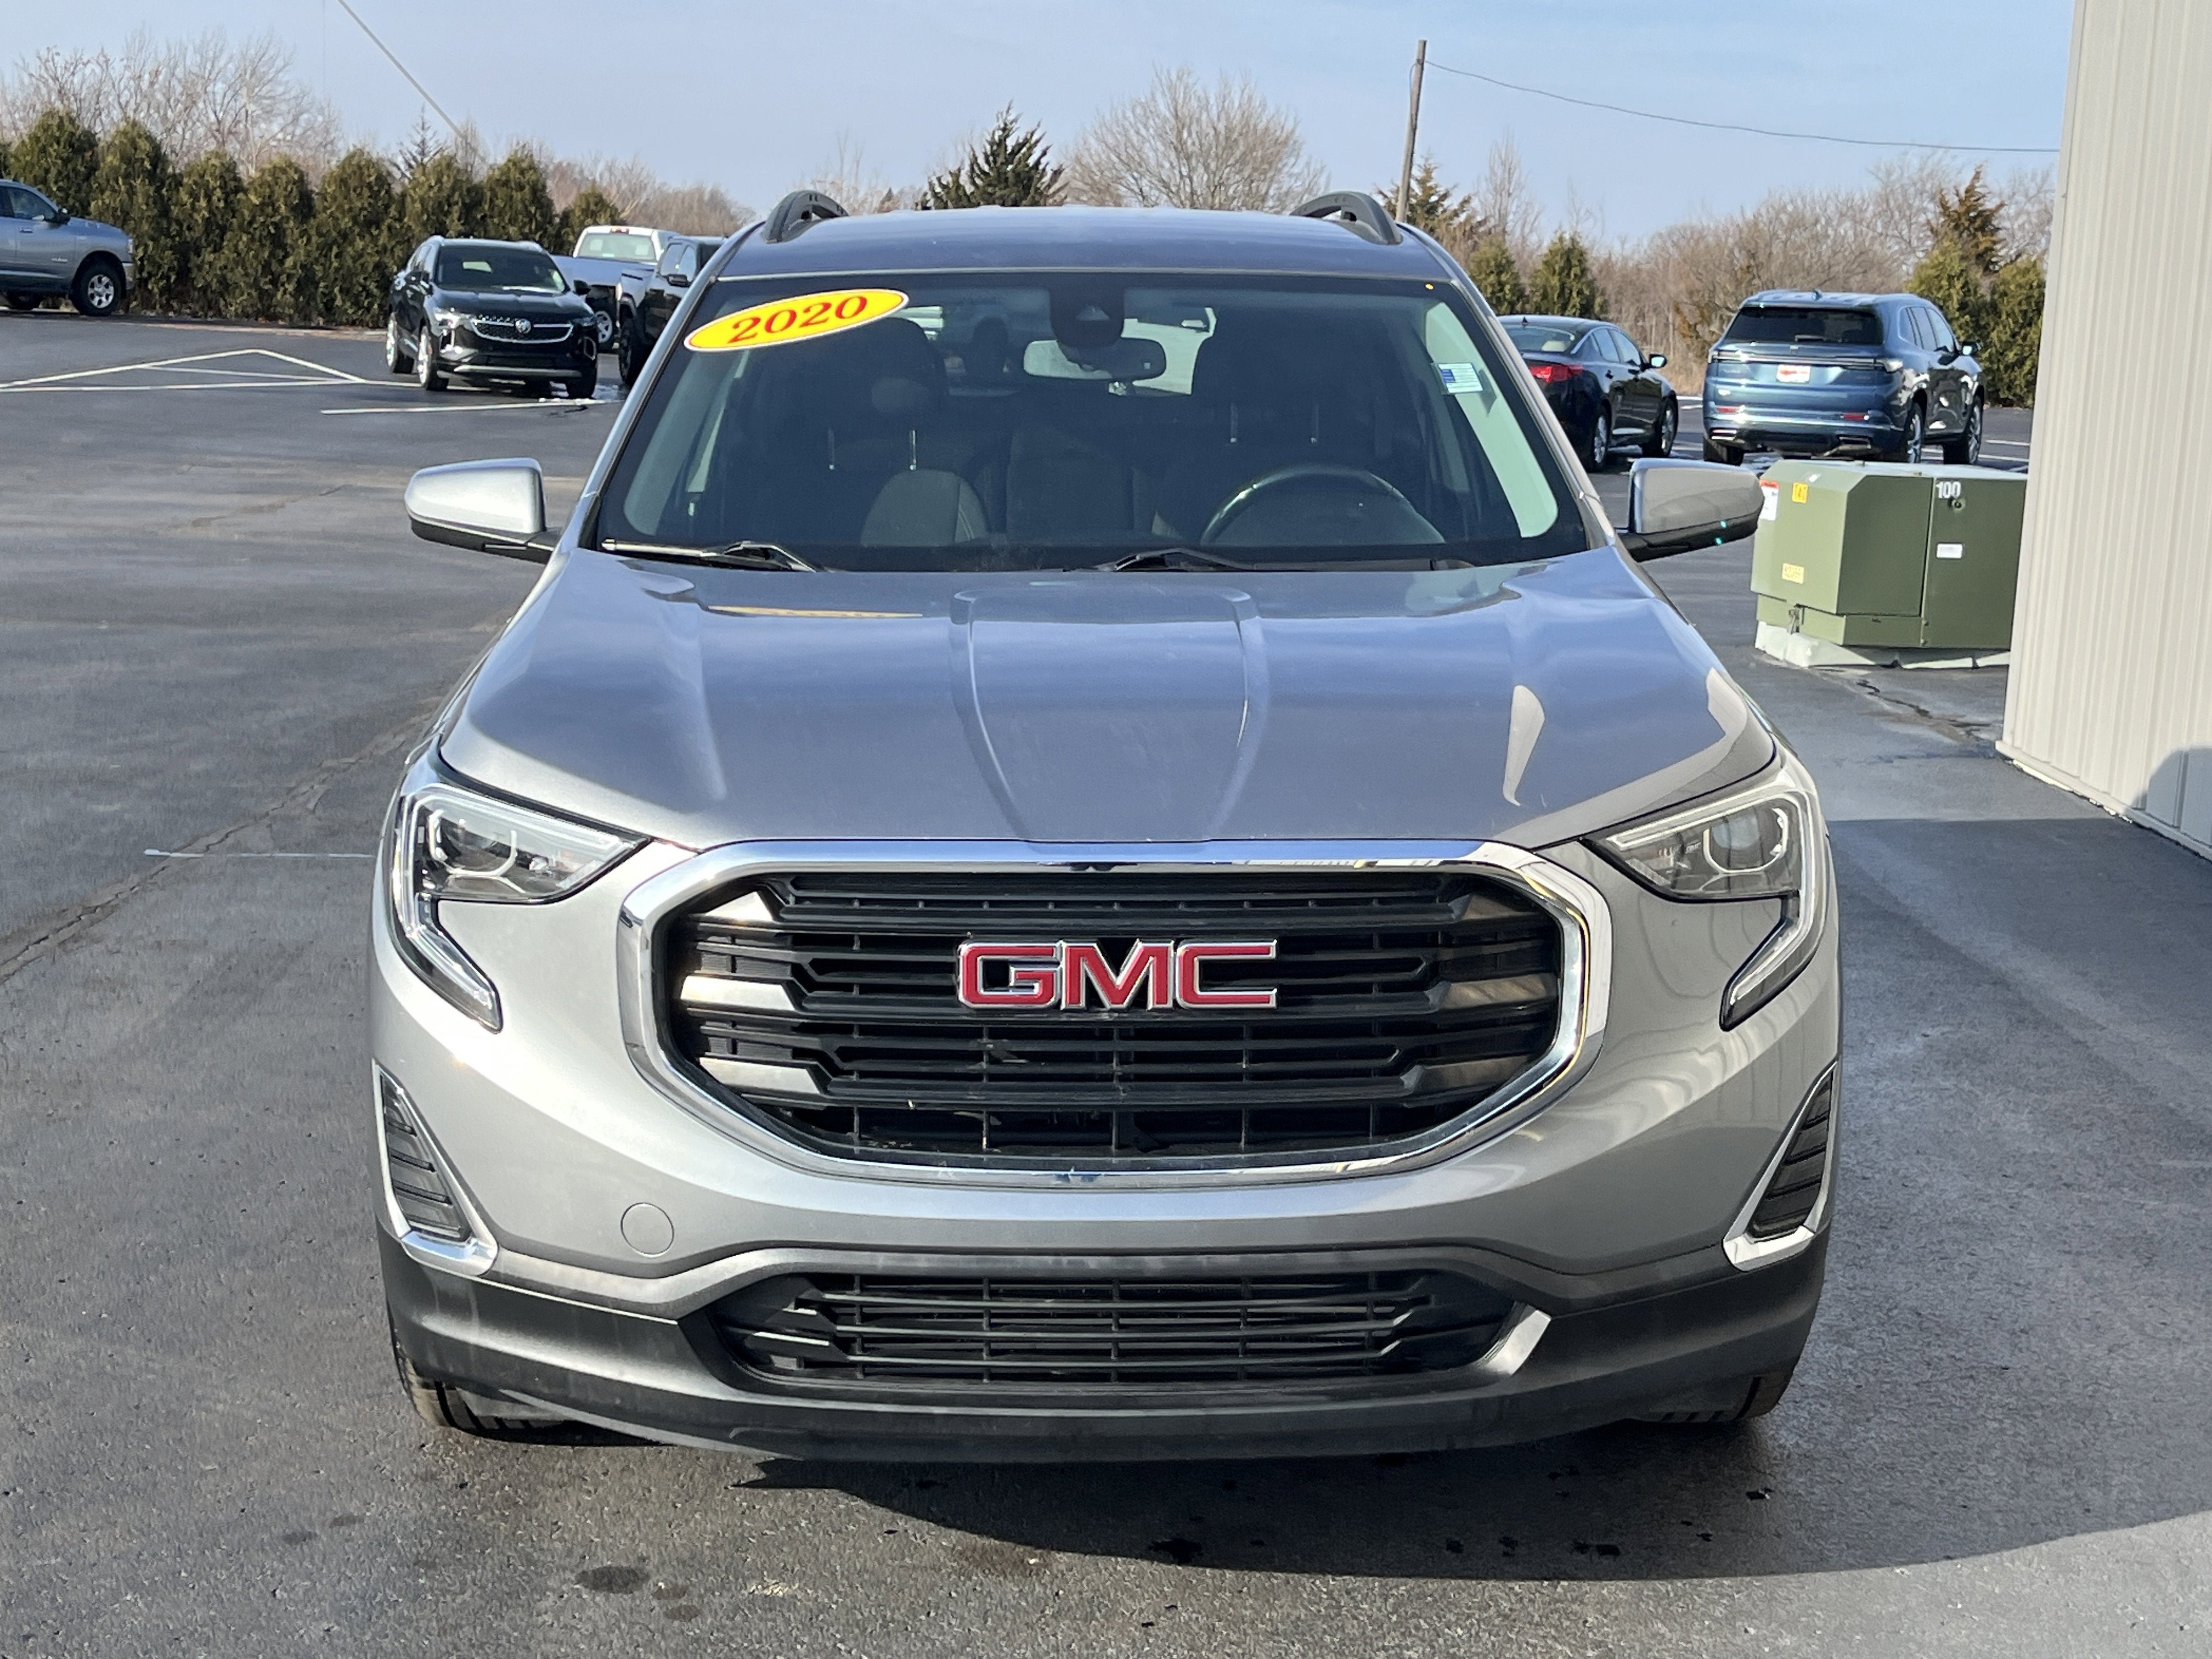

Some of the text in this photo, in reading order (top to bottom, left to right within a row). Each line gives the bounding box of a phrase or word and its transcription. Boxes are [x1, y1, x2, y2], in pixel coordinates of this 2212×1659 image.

[727, 296, 867, 343] 2020
[1936, 481, 1961, 499] 100
[958, 939, 1278, 1010] GMC
